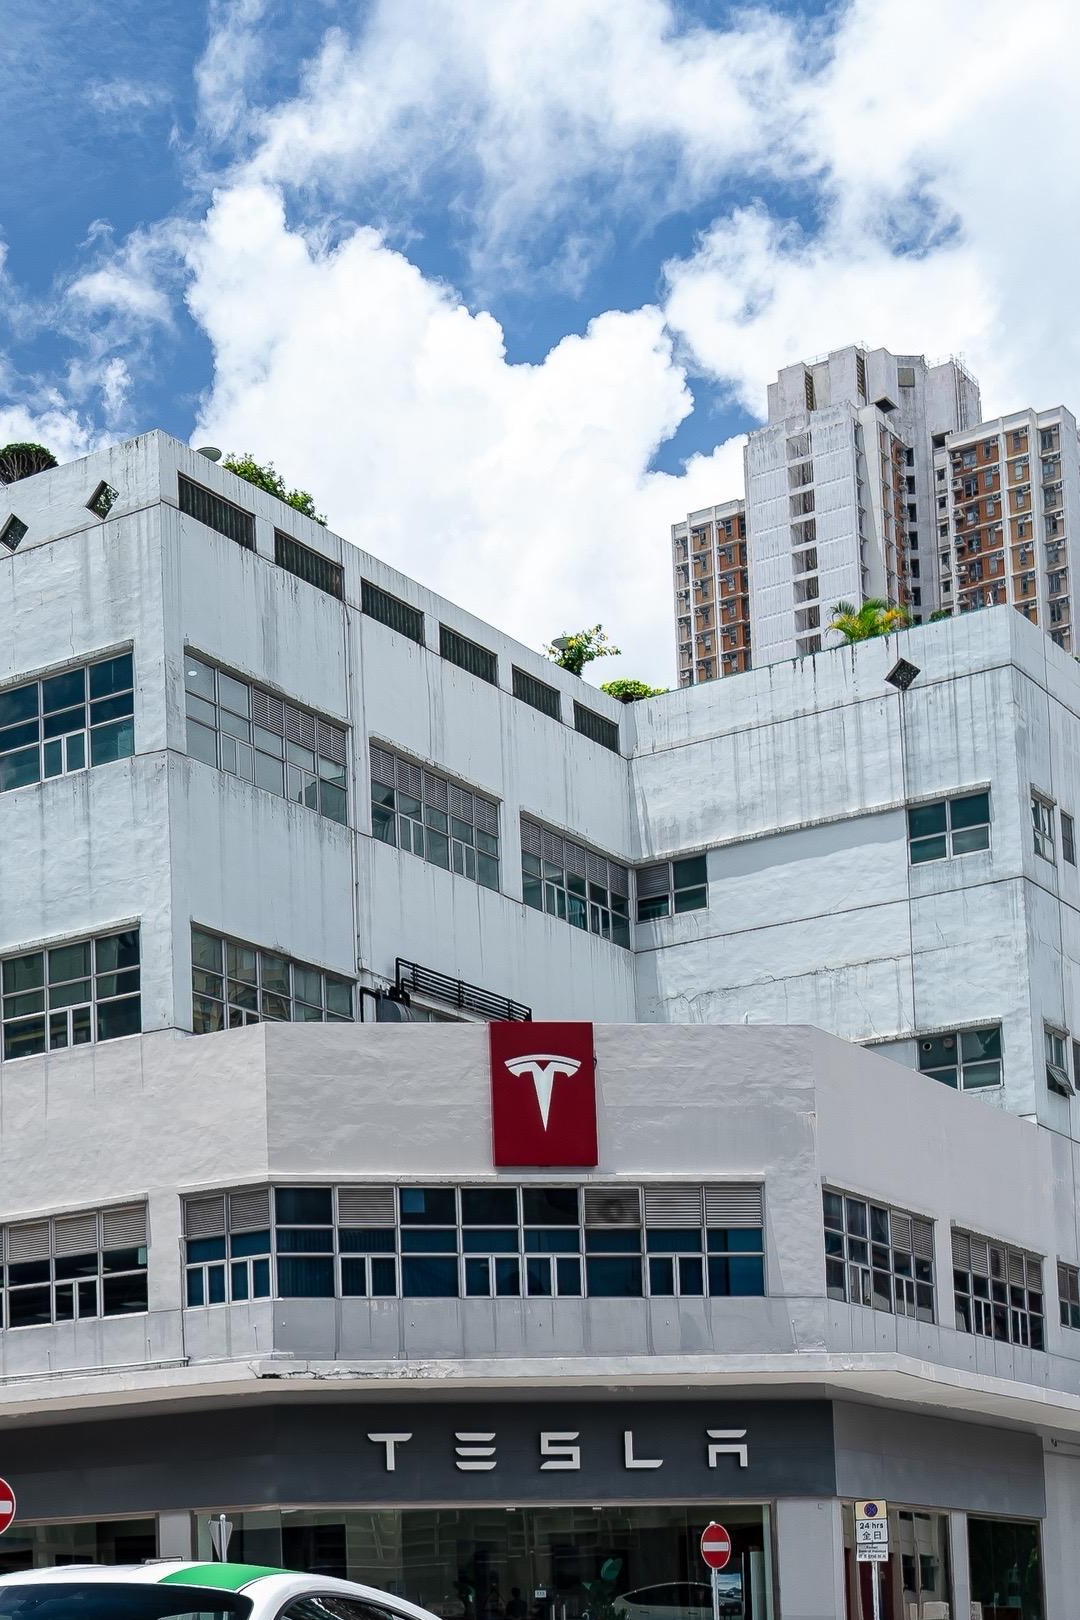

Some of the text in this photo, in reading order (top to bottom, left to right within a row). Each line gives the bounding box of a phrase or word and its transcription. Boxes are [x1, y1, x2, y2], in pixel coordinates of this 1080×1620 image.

[367, 1429, 748, 1471] TESLA
[859, 1522, 870, 1530] 24
[862, 1530, 882, 1541] 全日
